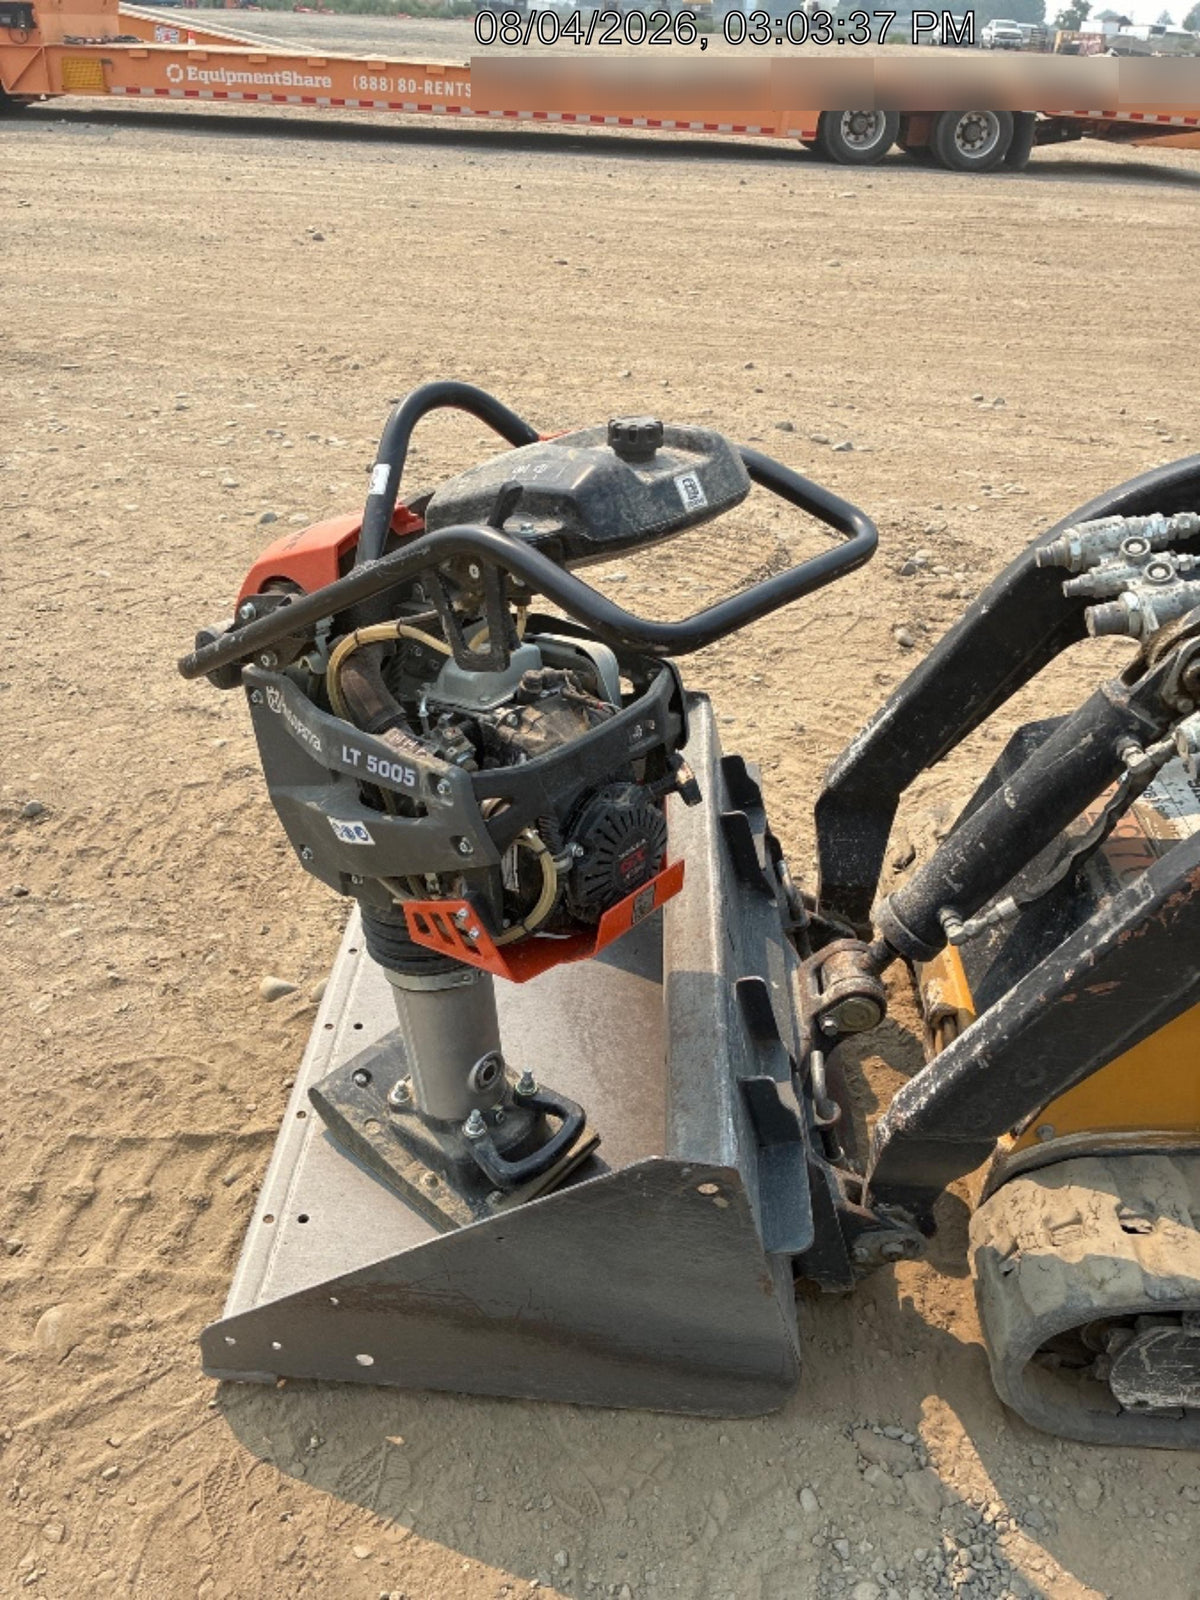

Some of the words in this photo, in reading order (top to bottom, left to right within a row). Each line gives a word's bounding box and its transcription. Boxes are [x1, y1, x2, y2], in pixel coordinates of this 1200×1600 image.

[187, 65, 332, 88] EquipmentShare
[353, 75, 394, 93] (888)
[398, 78, 471, 98] 80-RENTS
[342, 744, 361, 766] LT
[367, 754, 417, 787] 5005
